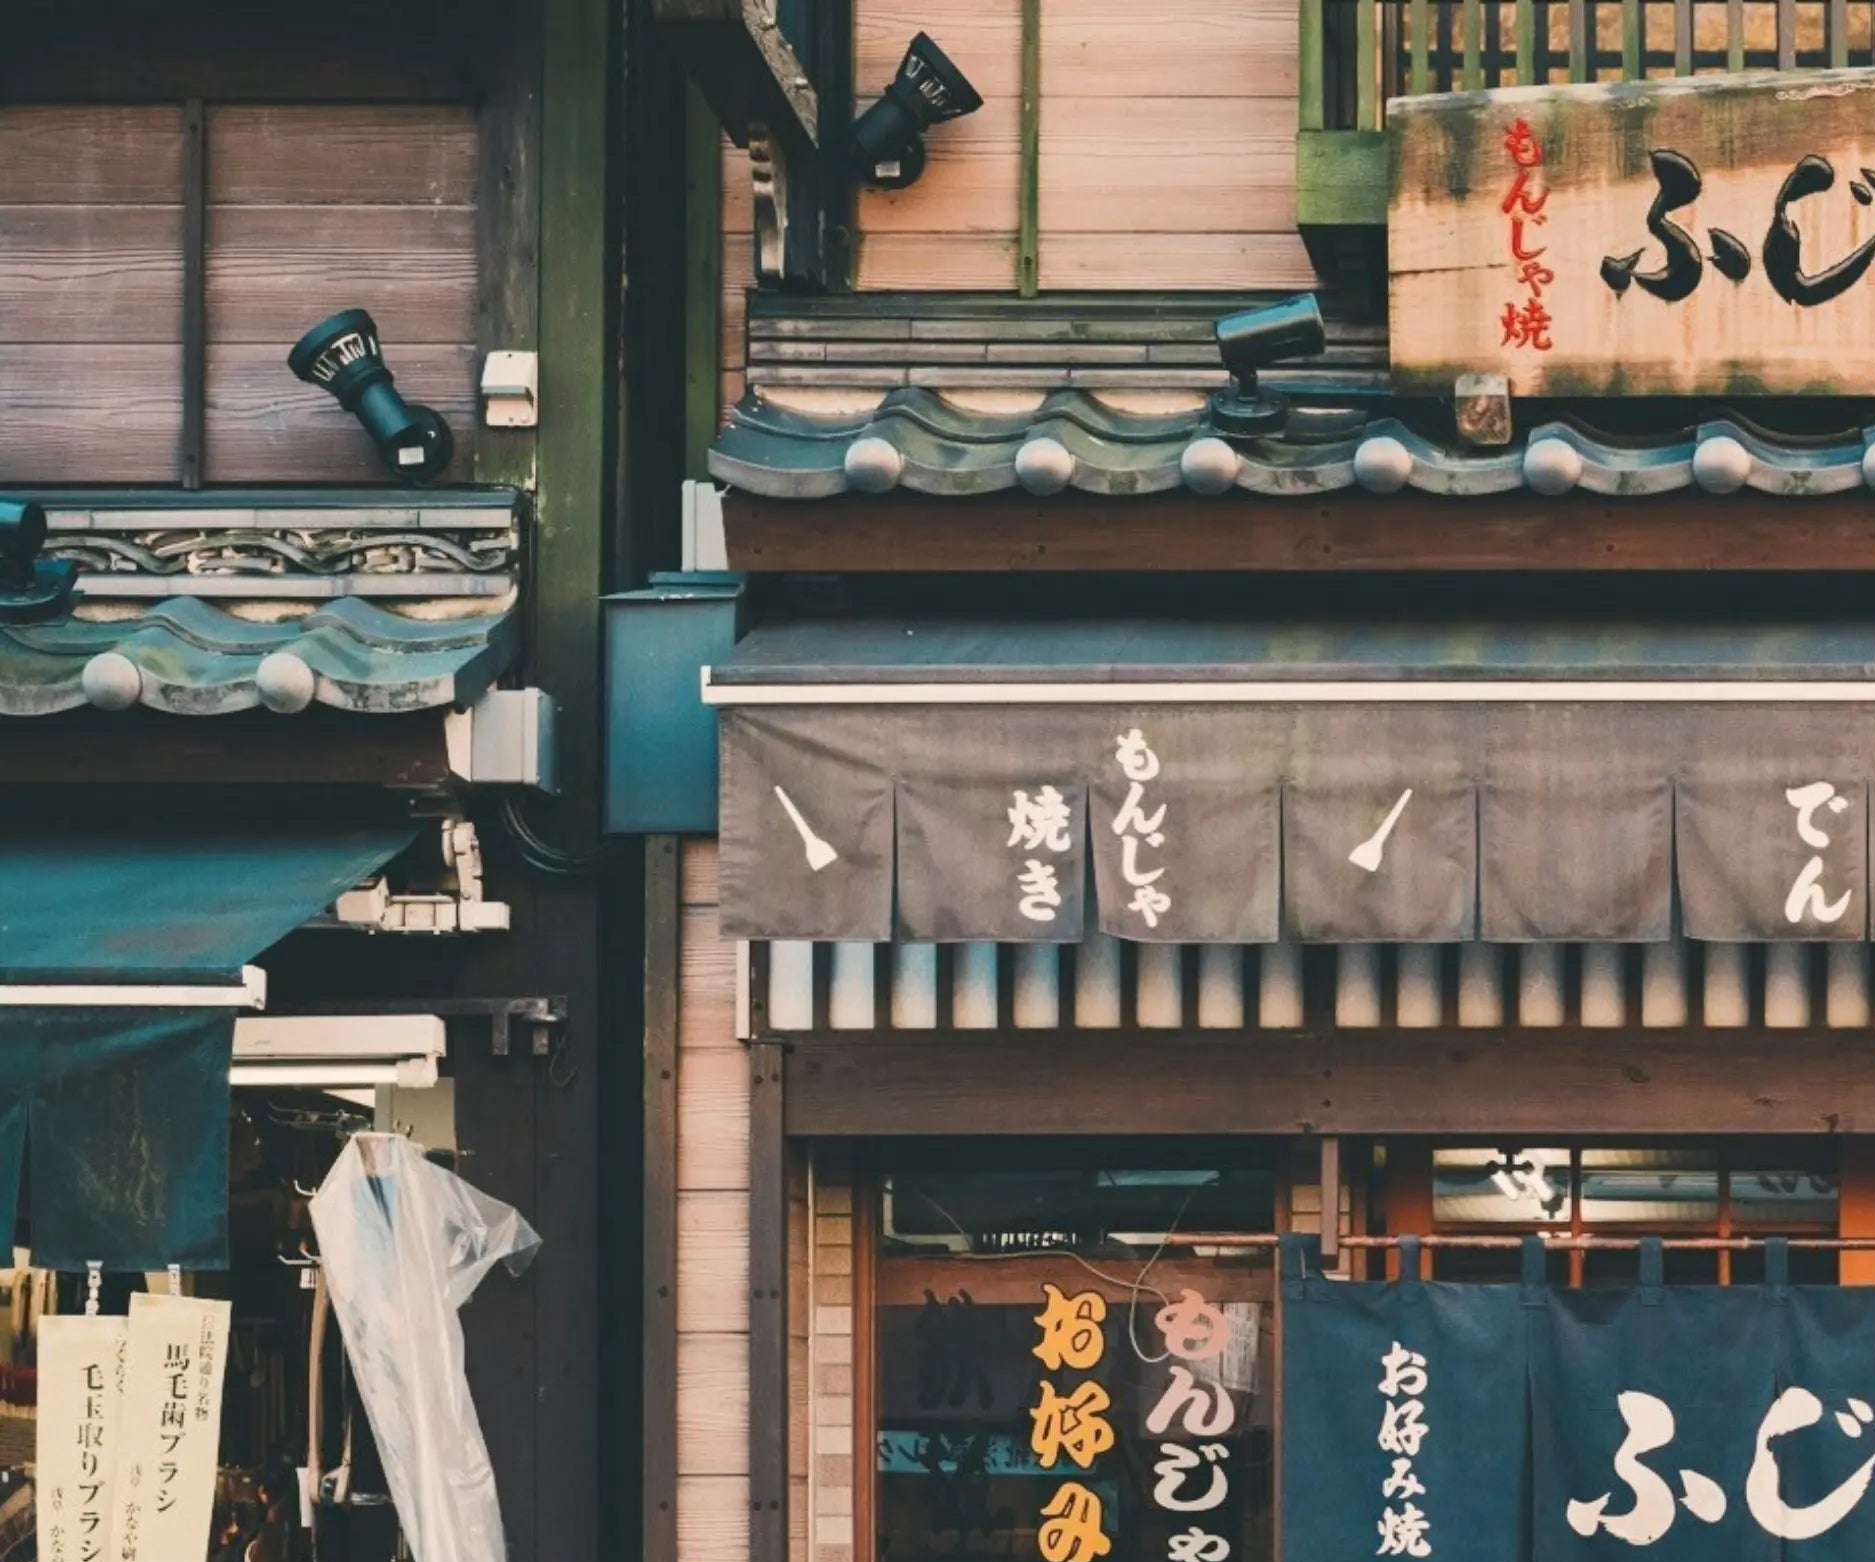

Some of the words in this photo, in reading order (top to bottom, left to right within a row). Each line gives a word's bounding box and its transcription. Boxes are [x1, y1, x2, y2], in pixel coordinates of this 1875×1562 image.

[1500, 117, 1553, 351] もんじゃ焼
[1006, 784, 1072, 922] 焼き
[1111, 728, 1171, 928] もんじゃ
[1784, 780, 1852, 924] でん
[76, 1363, 105, 1562] 毛玉取りブラシ
[157, 1344, 190, 1513] 馬毛歯ブラシ
[1375, 1341, 1432, 1559] お好み焼
